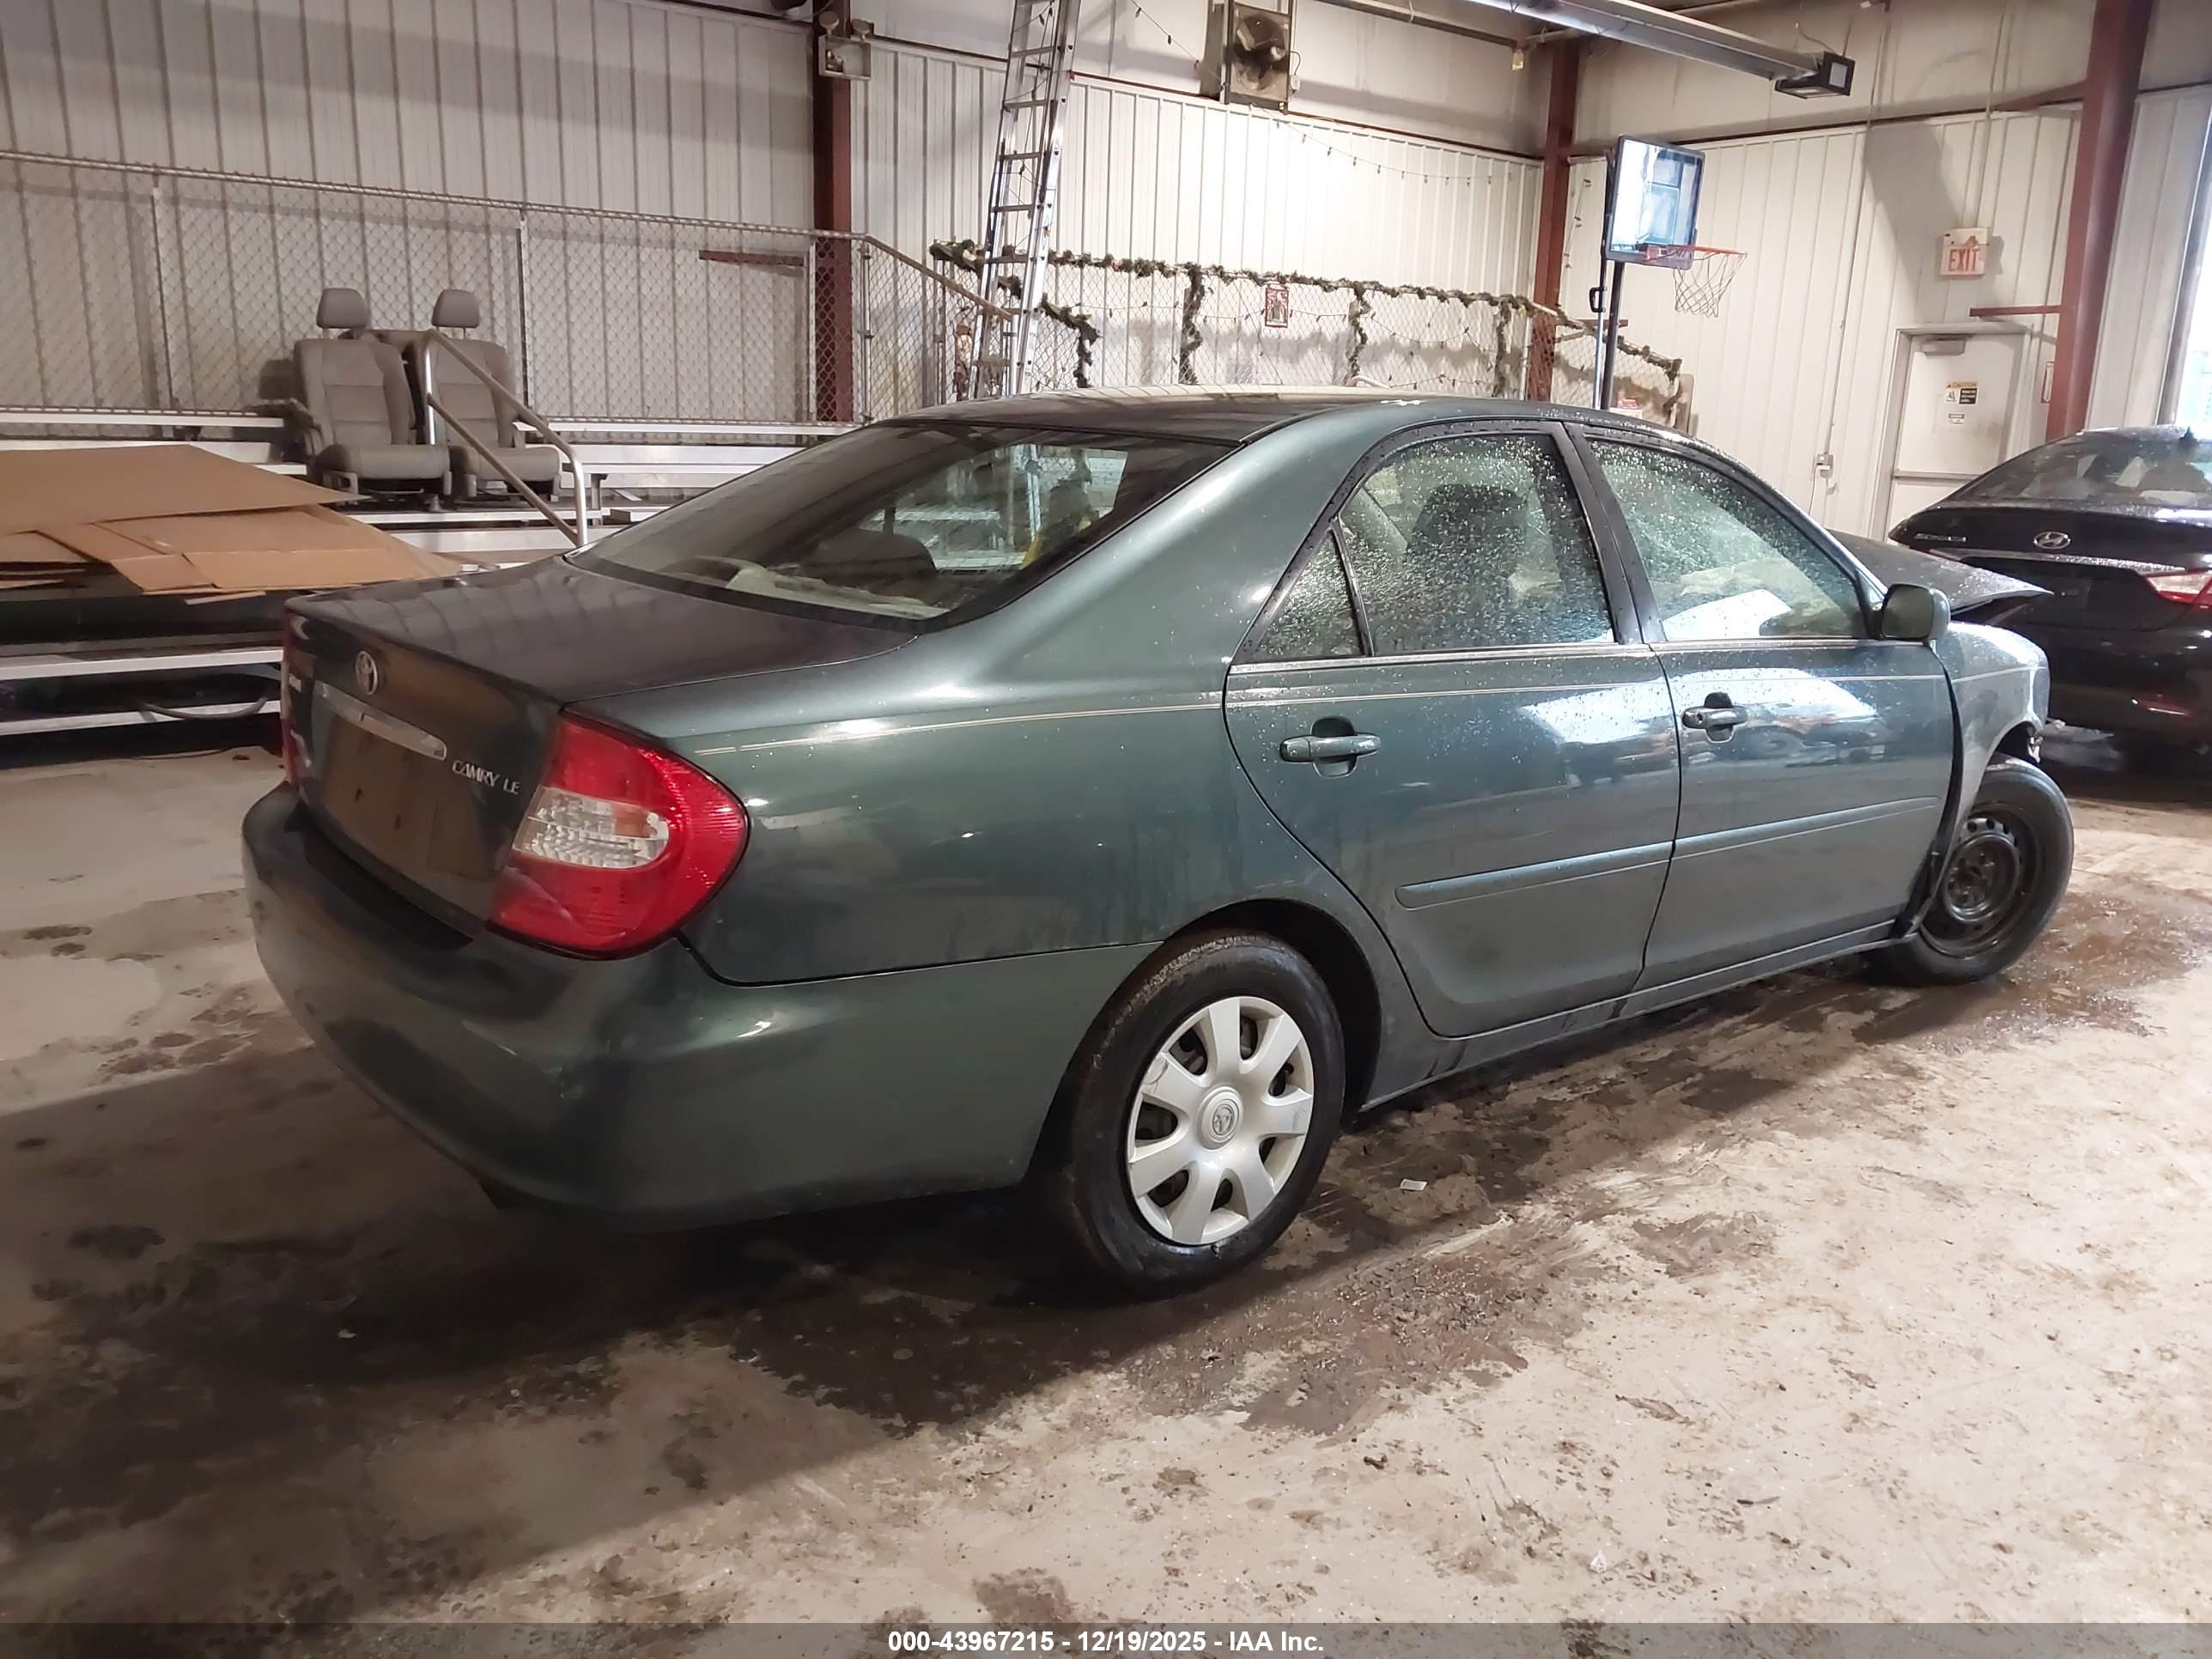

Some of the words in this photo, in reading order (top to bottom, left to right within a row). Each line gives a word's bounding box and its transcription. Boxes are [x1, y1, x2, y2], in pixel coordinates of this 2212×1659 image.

[1948, 249, 1980, 271] EXIT
[452, 760, 501, 787] CAMRY
[503, 778, 520, 795] LE
